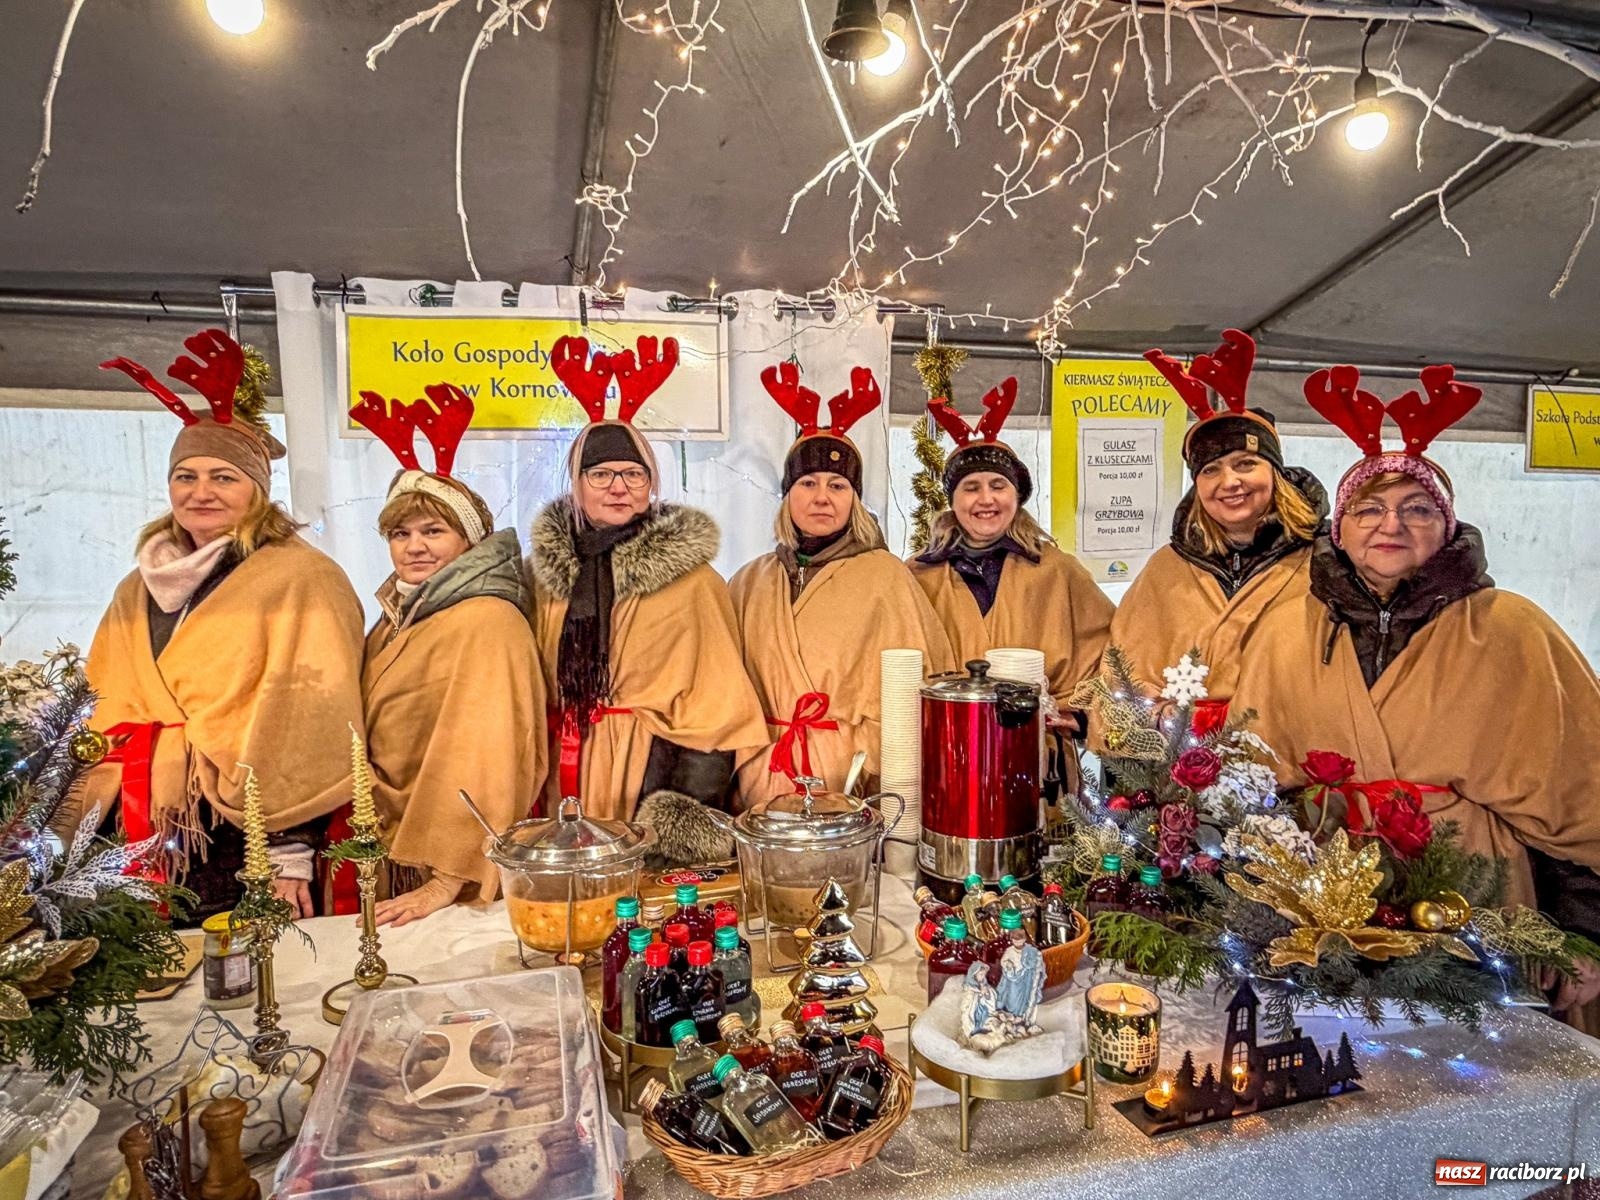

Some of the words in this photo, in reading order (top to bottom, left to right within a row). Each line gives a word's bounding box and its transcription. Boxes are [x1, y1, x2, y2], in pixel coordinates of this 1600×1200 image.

[392, 340, 444, 363] Koło
[454, 340, 553, 370] Gospody
[1064, 374, 1115, 386] KIERMASZ
[1118, 372, 1170, 390] ŚWIĄTECZ
[461, 384, 480, 398] w
[490, 377, 617, 398] Kornowu
[1072, 394, 1172, 417] POLECAMY
[1536, 409, 1570, 423] Szkoła
[1573, 410, 1600, 425] Podst
[1103, 440, 1136, 450] GULASZ
[1087, 455, 1093, 465] Z
[1095, 454, 1153, 464] KLUSECZKAMI
[1098, 472, 1118, 480] Porcja
[1119, 472, 1137, 480] 10,00
[1110, 496, 1132, 505] ZUPA
[1095, 510, 1144, 519] GRZYBOWA
[1097, 527, 1117, 535] Porcja
